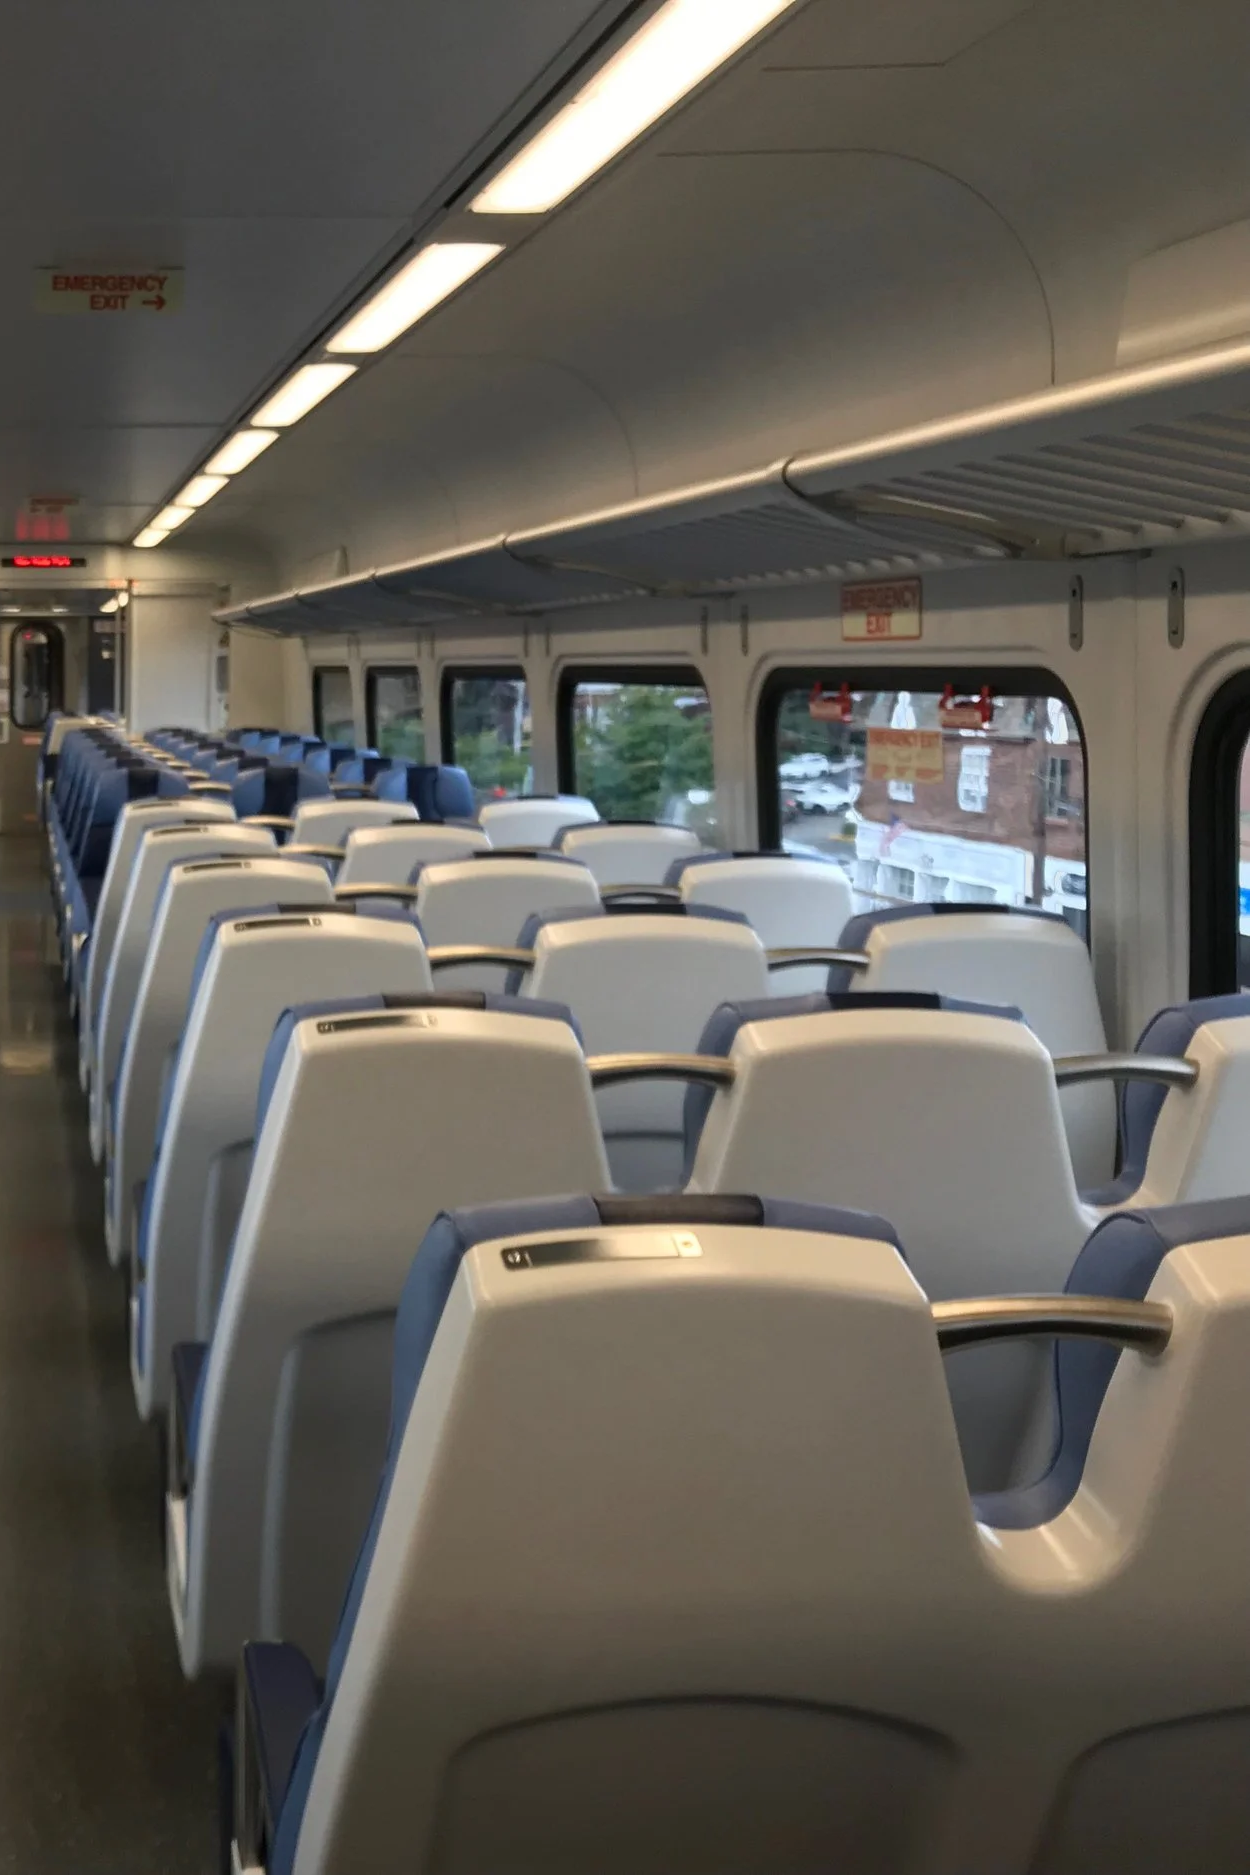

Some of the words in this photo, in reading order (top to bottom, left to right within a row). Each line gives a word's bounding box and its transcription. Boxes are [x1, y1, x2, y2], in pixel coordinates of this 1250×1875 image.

[52, 274, 168, 291] EMERGENCY
[90, 295, 130, 310] EXIT
[866, 612, 892, 634] EXIT
